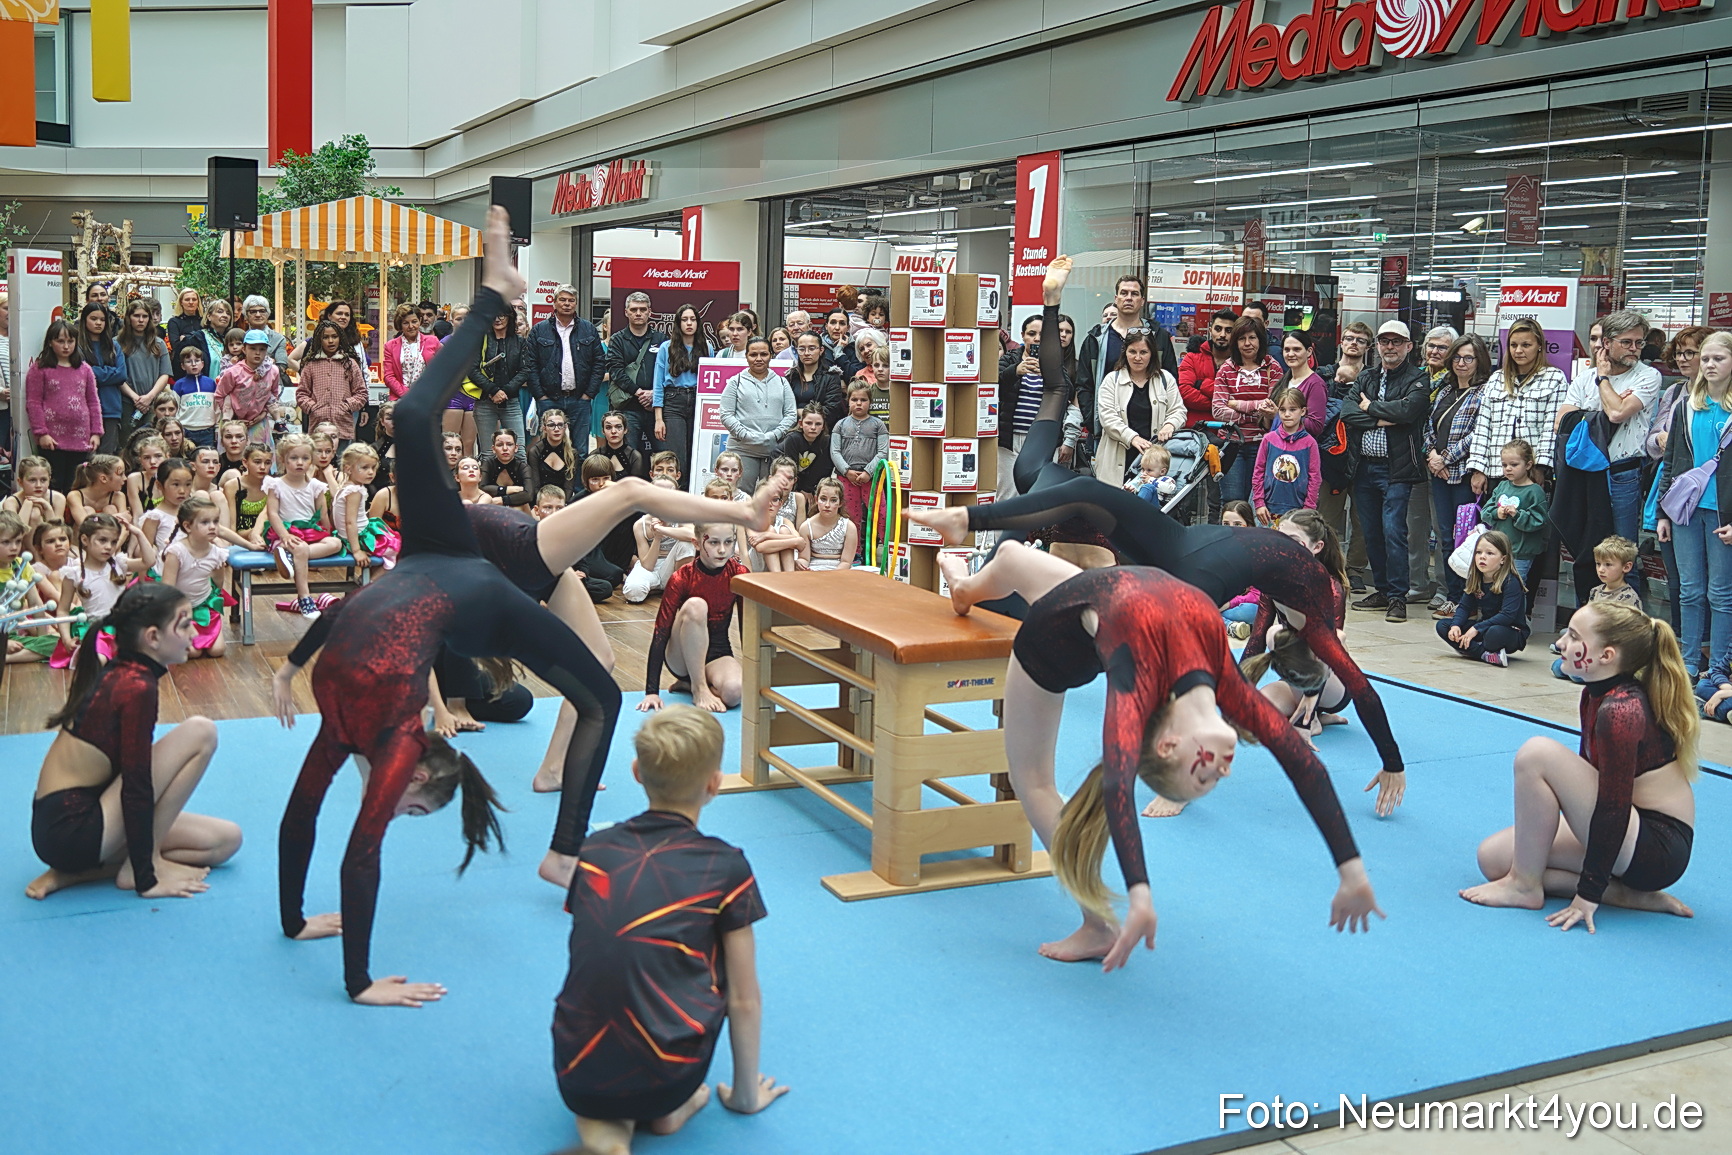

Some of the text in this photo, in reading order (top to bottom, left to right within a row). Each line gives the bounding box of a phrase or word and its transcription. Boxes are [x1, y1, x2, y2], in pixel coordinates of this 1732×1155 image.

[551, 158, 650, 214] Media Markt
[1029, 164, 1048, 238] 1
[1022, 246, 1047, 260] Stunde
[643, 268, 706, 279] Media Markt
[1183, 270, 1243, 287] SOFTWAR
[1520, 289, 1560, 304] Markt
[947, 677, 995, 688] SPORT-THEME
